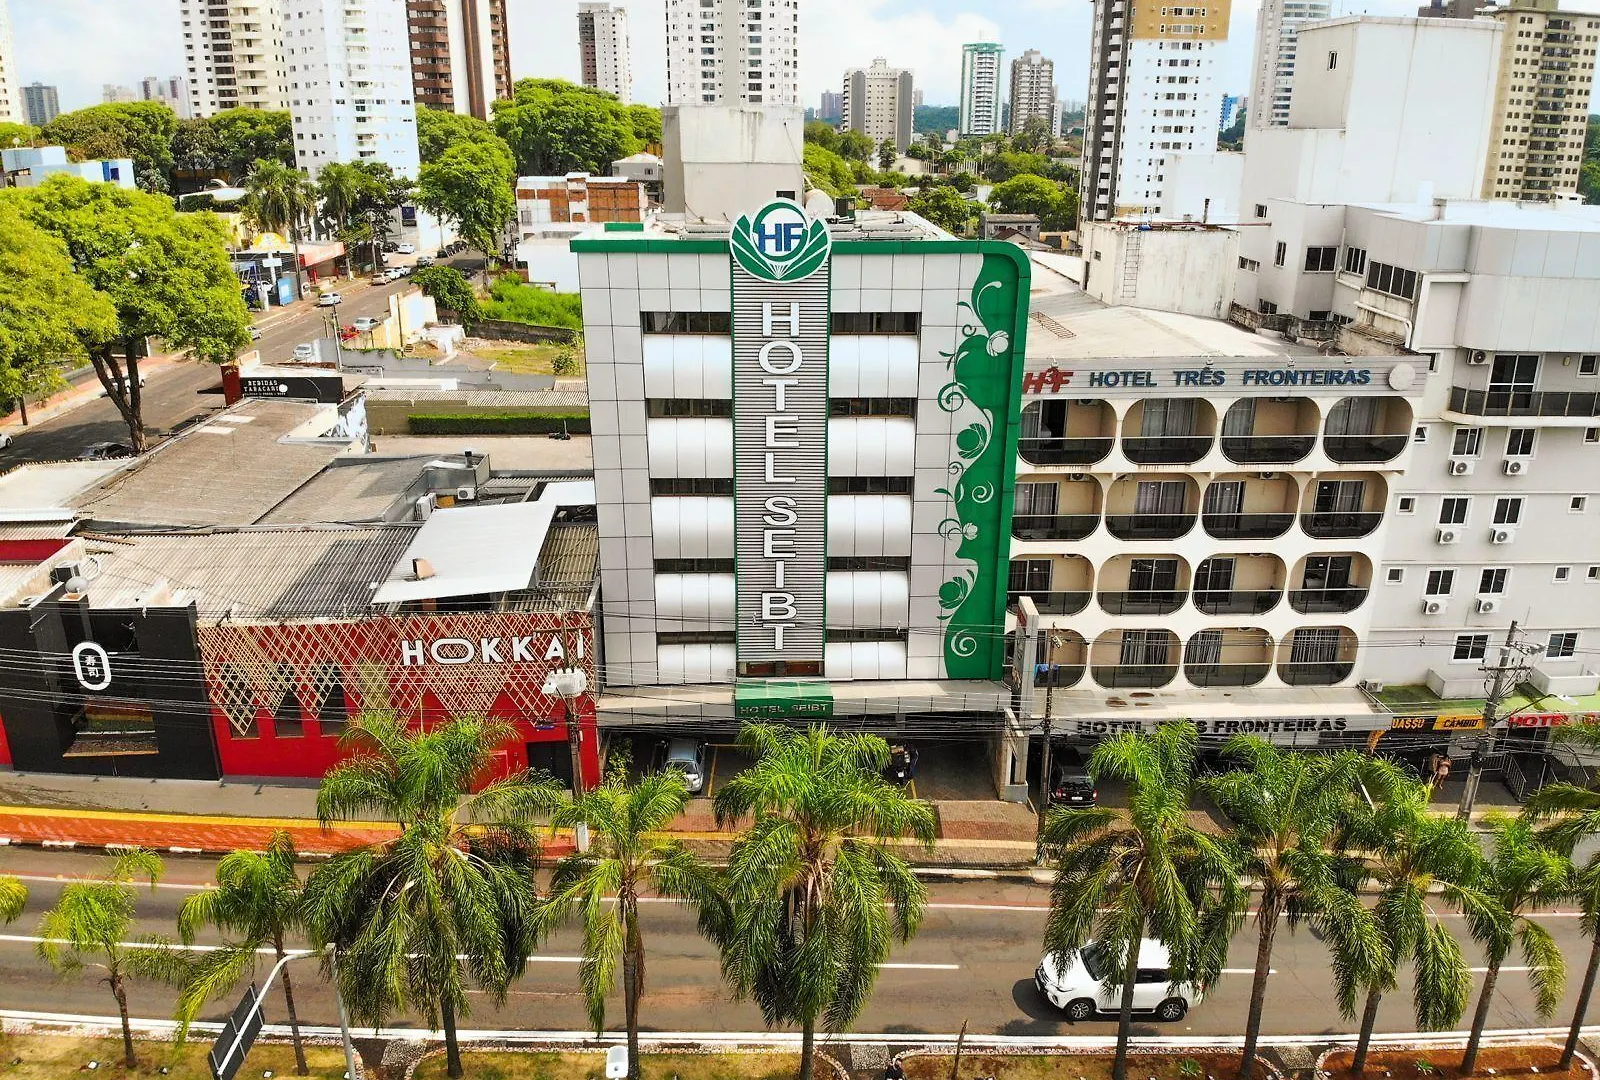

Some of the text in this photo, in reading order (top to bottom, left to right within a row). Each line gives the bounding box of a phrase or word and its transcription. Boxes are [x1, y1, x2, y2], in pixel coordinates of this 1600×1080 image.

[758, 223, 804, 253] HF
[1089, 366, 1371, 388] HOTEL TRÊS FRONTEIRAS
[758, 301, 803, 650] HOTEL SEIBT
[401, 629, 585, 666] HOKKAI
[740, 703, 829, 715] HOTEL SEIBT
[1213, 717, 1348, 732] FRONTEIRAS
[1391, 716, 1479, 729] UASSU CÂMBIO
